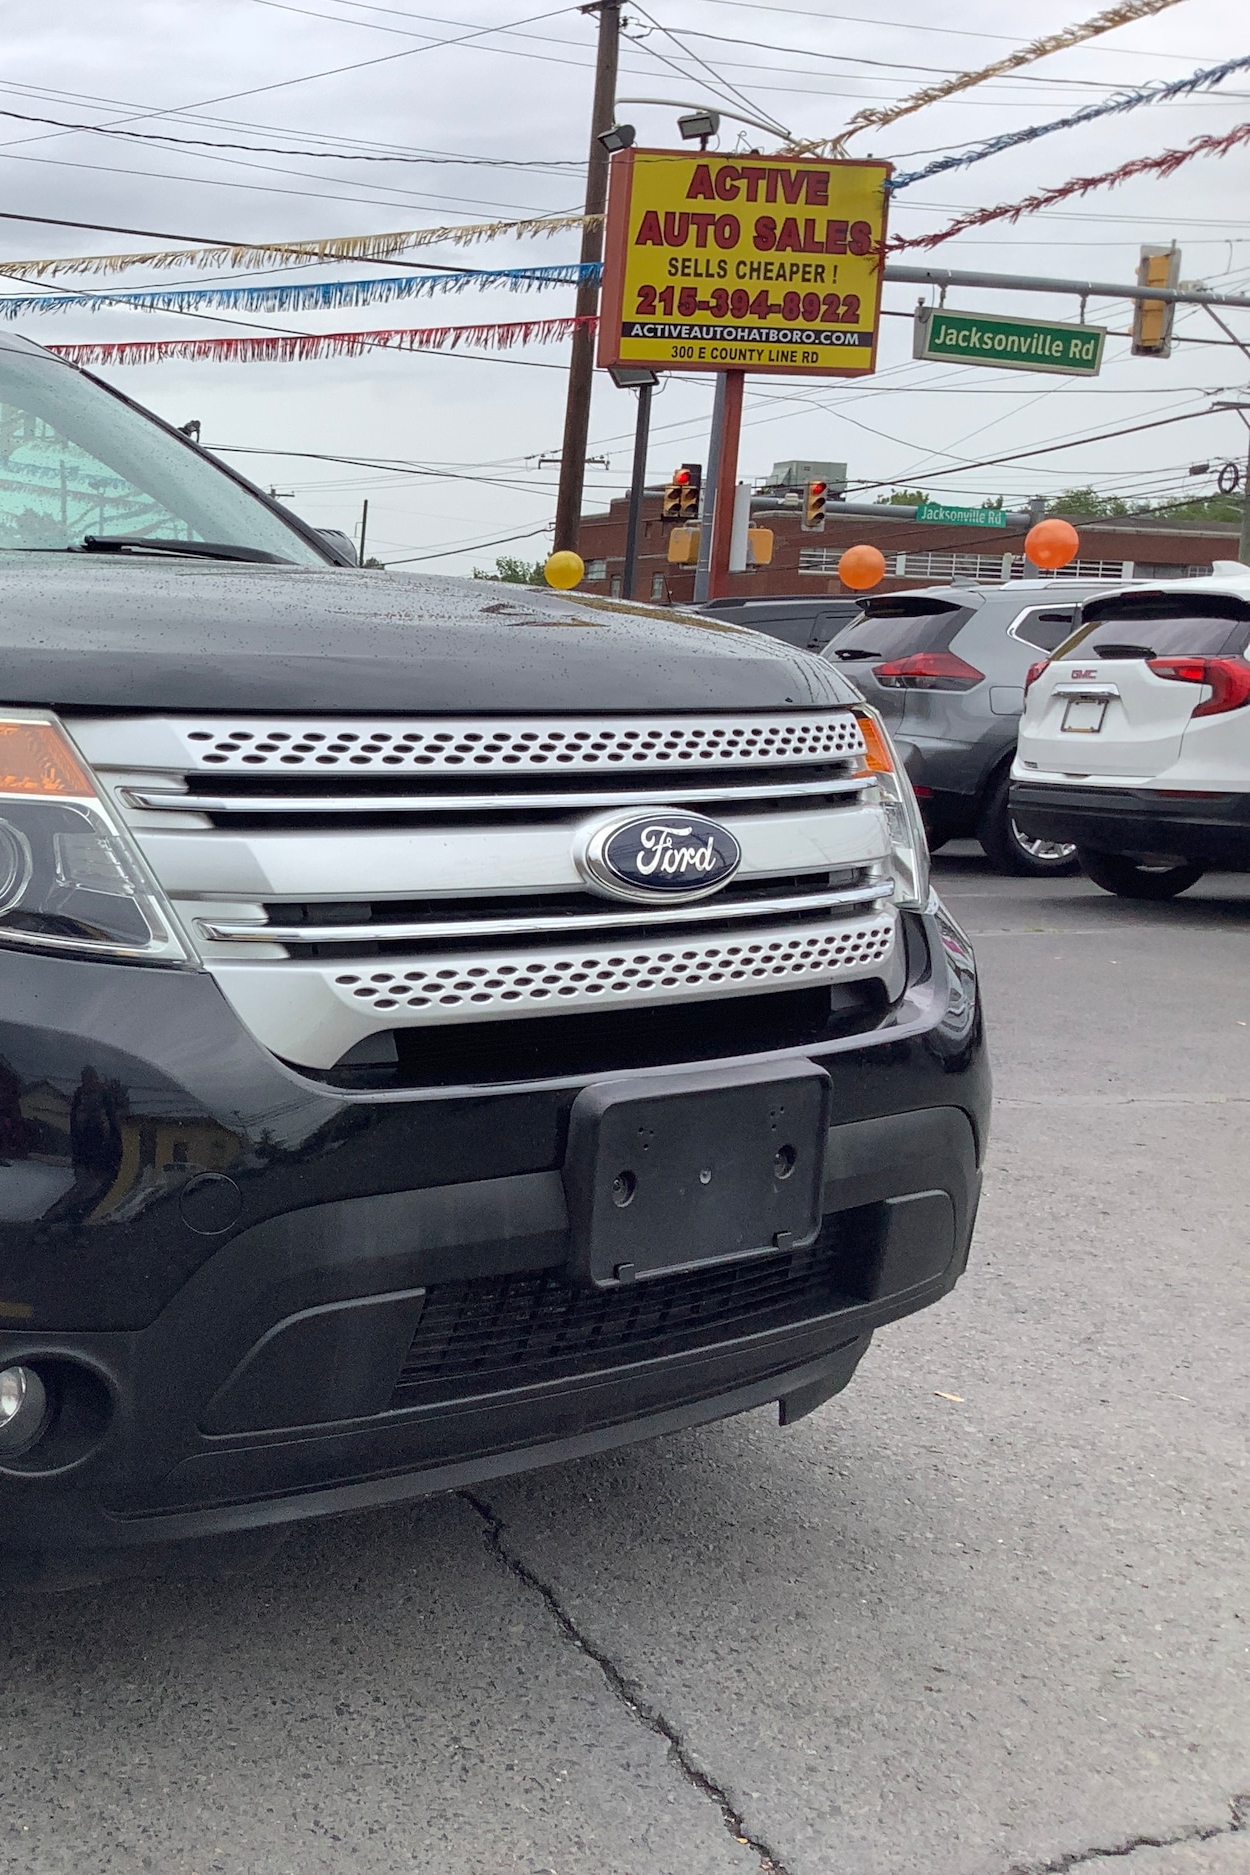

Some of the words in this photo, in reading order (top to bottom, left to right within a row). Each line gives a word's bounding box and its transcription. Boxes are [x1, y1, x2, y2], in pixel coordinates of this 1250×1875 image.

[686, 164, 831, 206] ACTIVE
[635, 210, 741, 250] AUTO
[752, 216, 873, 256] SALES
[667, 257, 729, 279] SELLS
[735, 260, 827, 284] CHEAPER
[635, 285, 861, 324] 215-394-8922
[631, 324, 859, 345] ACTIVEAUTOHATBORO.COM
[934, 324, 1064, 358] Jacksonville
[1068, 339, 1095, 360] Rd
[671, 345, 694, 359] 300
[698, 346, 706, 359] E
[710, 347, 765, 362] COUNTY
[768, 349, 798, 363] LINE
[802, 351, 819, 364] RD
[921, 506, 986, 524] Jacksonville
[988, 510, 1002, 525] Rd
[1071, 669, 1098, 680] GMC
[636, 825, 717, 875] Ford
